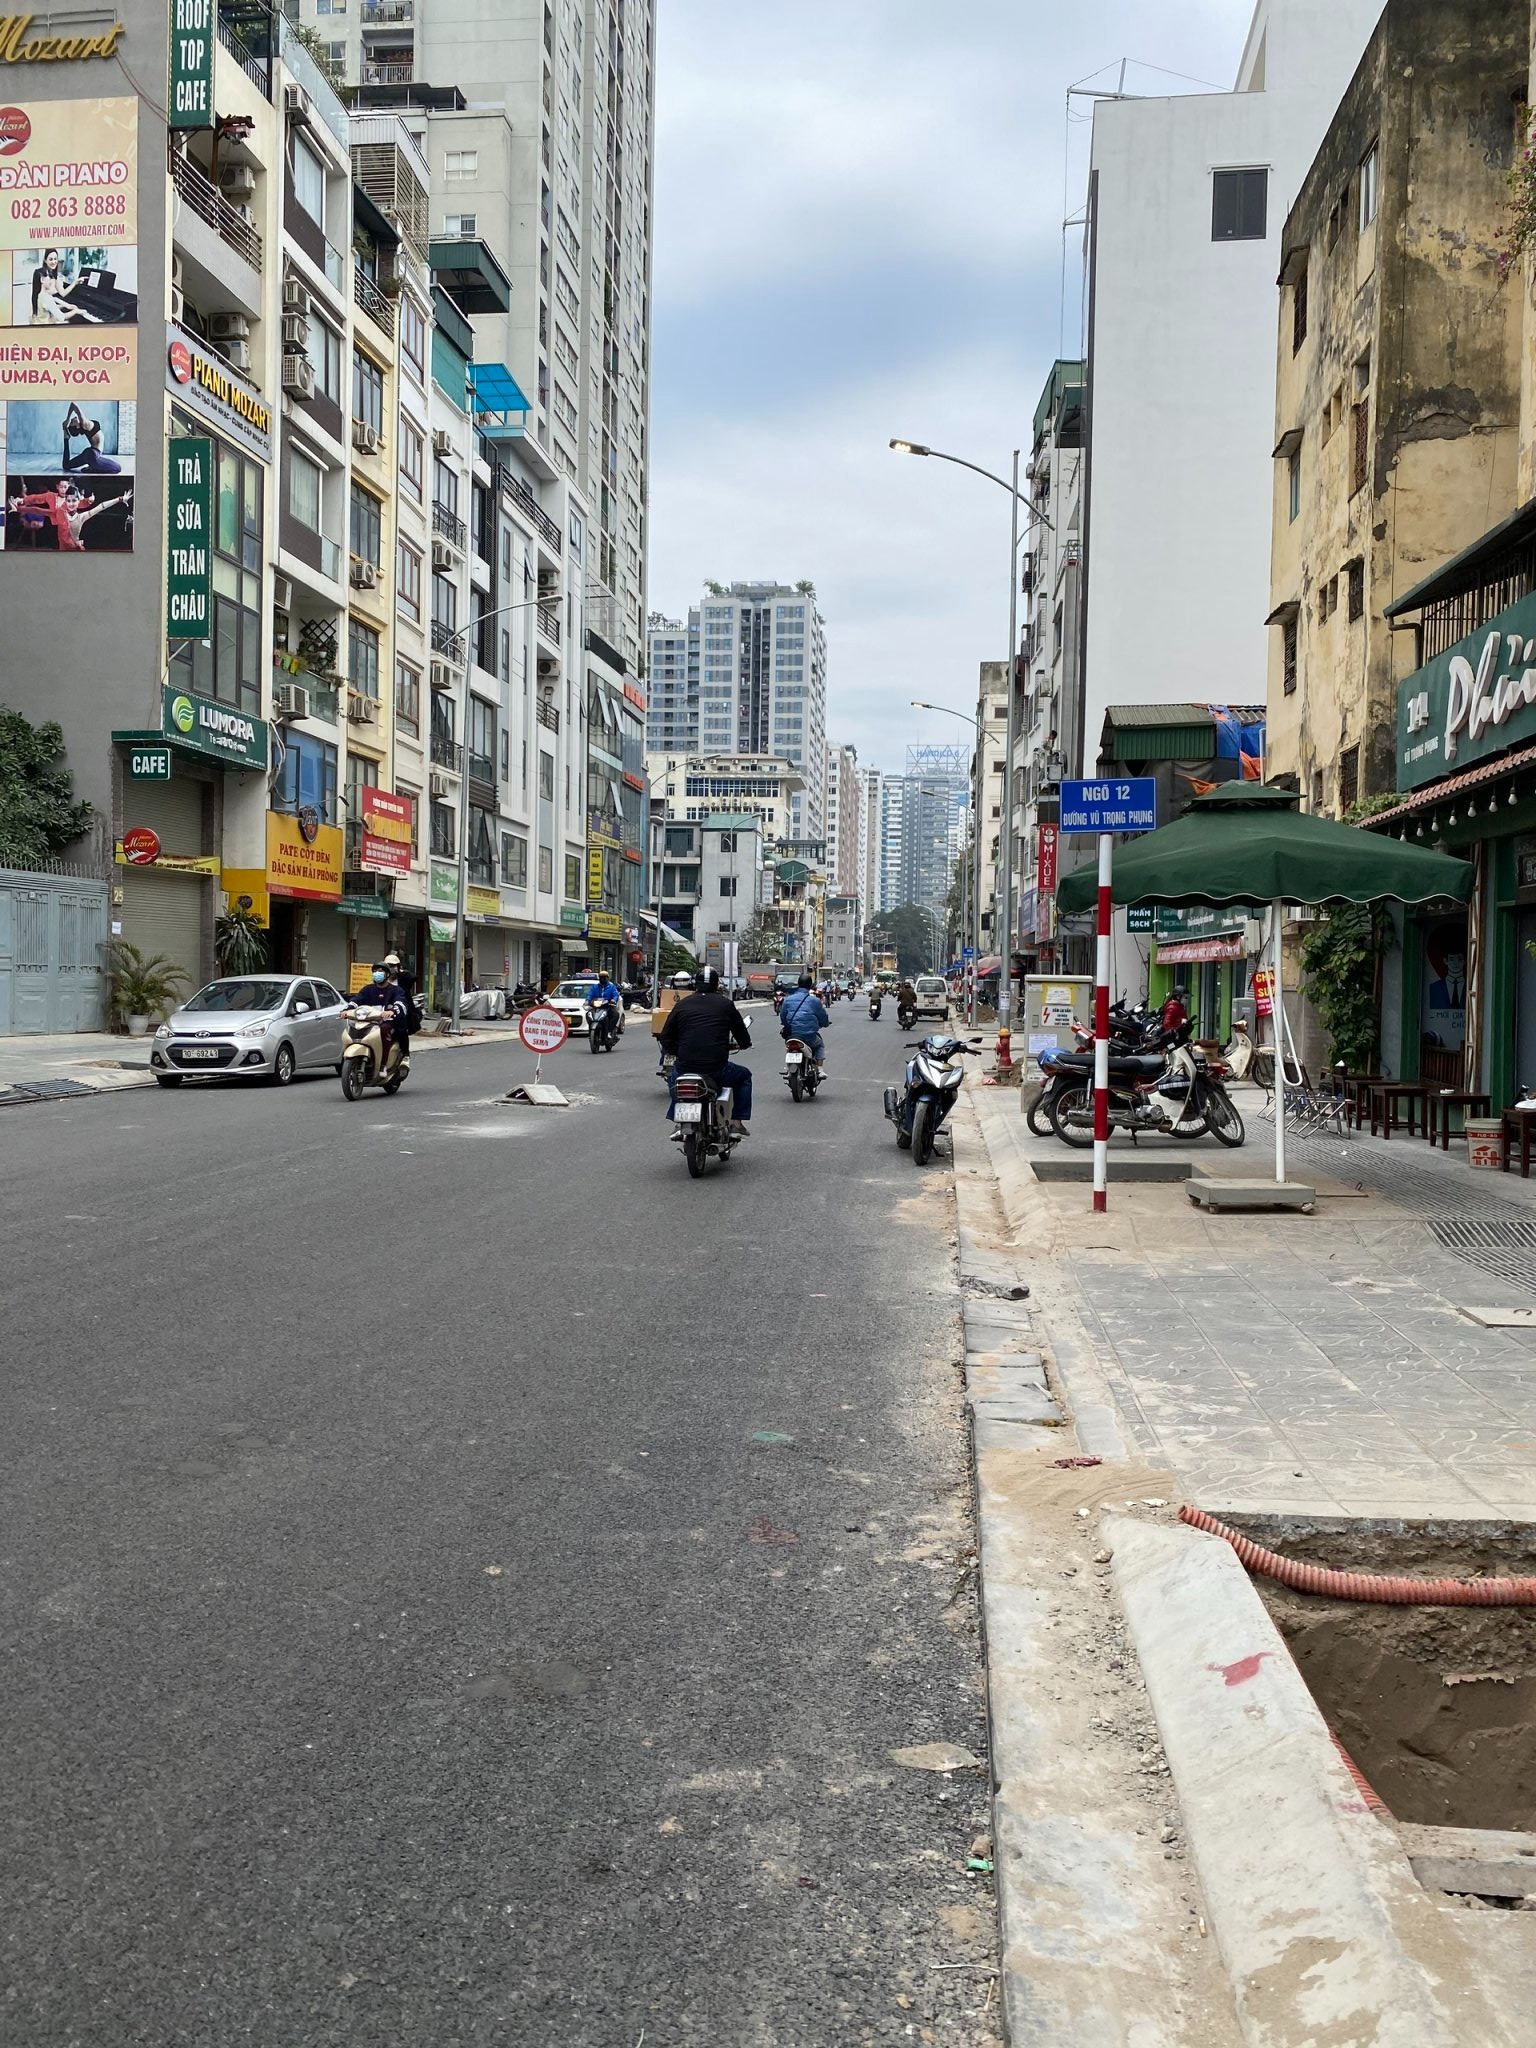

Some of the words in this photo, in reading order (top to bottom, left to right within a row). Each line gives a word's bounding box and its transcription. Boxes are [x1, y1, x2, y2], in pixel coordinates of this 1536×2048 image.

[176, 0, 210, 30] ROOF
[0, 14, 124, 61] Mozart
[180, 40, 204, 71] TOP
[176, 80, 207, 112] CAFE
[0, 161, 50, 189] ĐÀN
[54, 161, 129, 188] PIANO
[11, 199, 41, 220] 082
[47, 197, 78, 218] 863
[84, 195, 126, 216] 8888
[29, 223, 125, 239] WWW.PIANOMOZART.COM
[37, 347, 73, 365] ĐẠI,
[78, 347, 130, 364] KPOP,
[0, 370, 57, 386] UMBA,
[62, 370, 110, 384] YOGA
[193, 354, 229, 401] PIANO
[230, 383, 272, 434] MOZART
[178, 453, 201, 484] TRÀ
[176, 499, 202, 530] SỮA
[172, 543, 205, 575] TRÂN
[171, 589, 205, 620] CHÂU
[200, 706, 255, 742] LUMORA
[132, 756, 166, 773] CAFE
[1082, 784, 1109, 801] NGÕ
[1116, 785, 1130, 800] 12
[1063, 810, 1087, 826] ĐƯỜNG
[1090, 810, 1099, 825] VŨ
[1103, 811, 1126, 826] TRỌNG
[1128, 810, 1153, 825] PHỤNG
[280, 843, 298, 858] PATE
[300, 847, 315, 863] CỘT
[1043, 844, 1053, 886] MIXUE
[272, 858, 286, 877] ĐẶC
[316, 867, 339, 883] PHÒNG
[114, 889, 124, 902] 25
